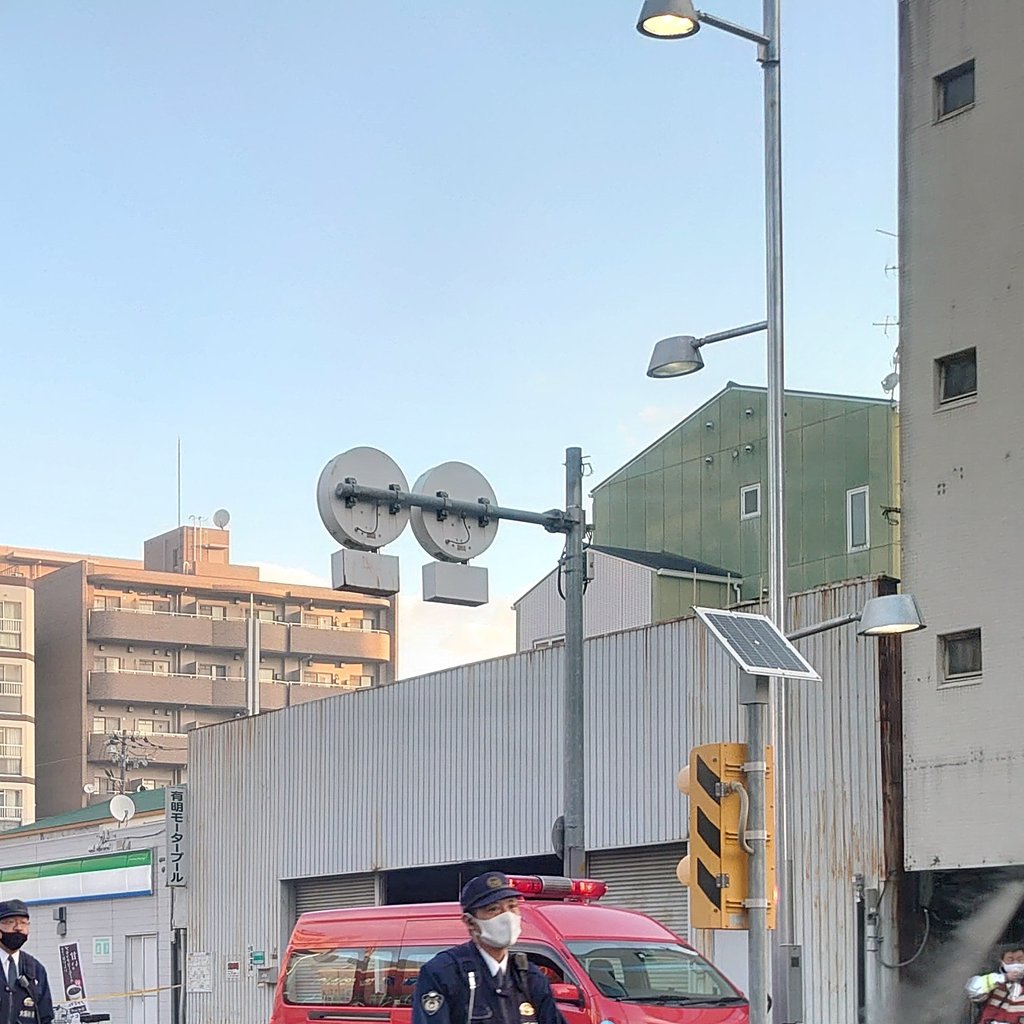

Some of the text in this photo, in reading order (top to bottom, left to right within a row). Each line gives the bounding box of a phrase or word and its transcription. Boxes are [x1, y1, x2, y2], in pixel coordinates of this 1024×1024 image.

[170, 791, 184, 883] 有明モータープール
